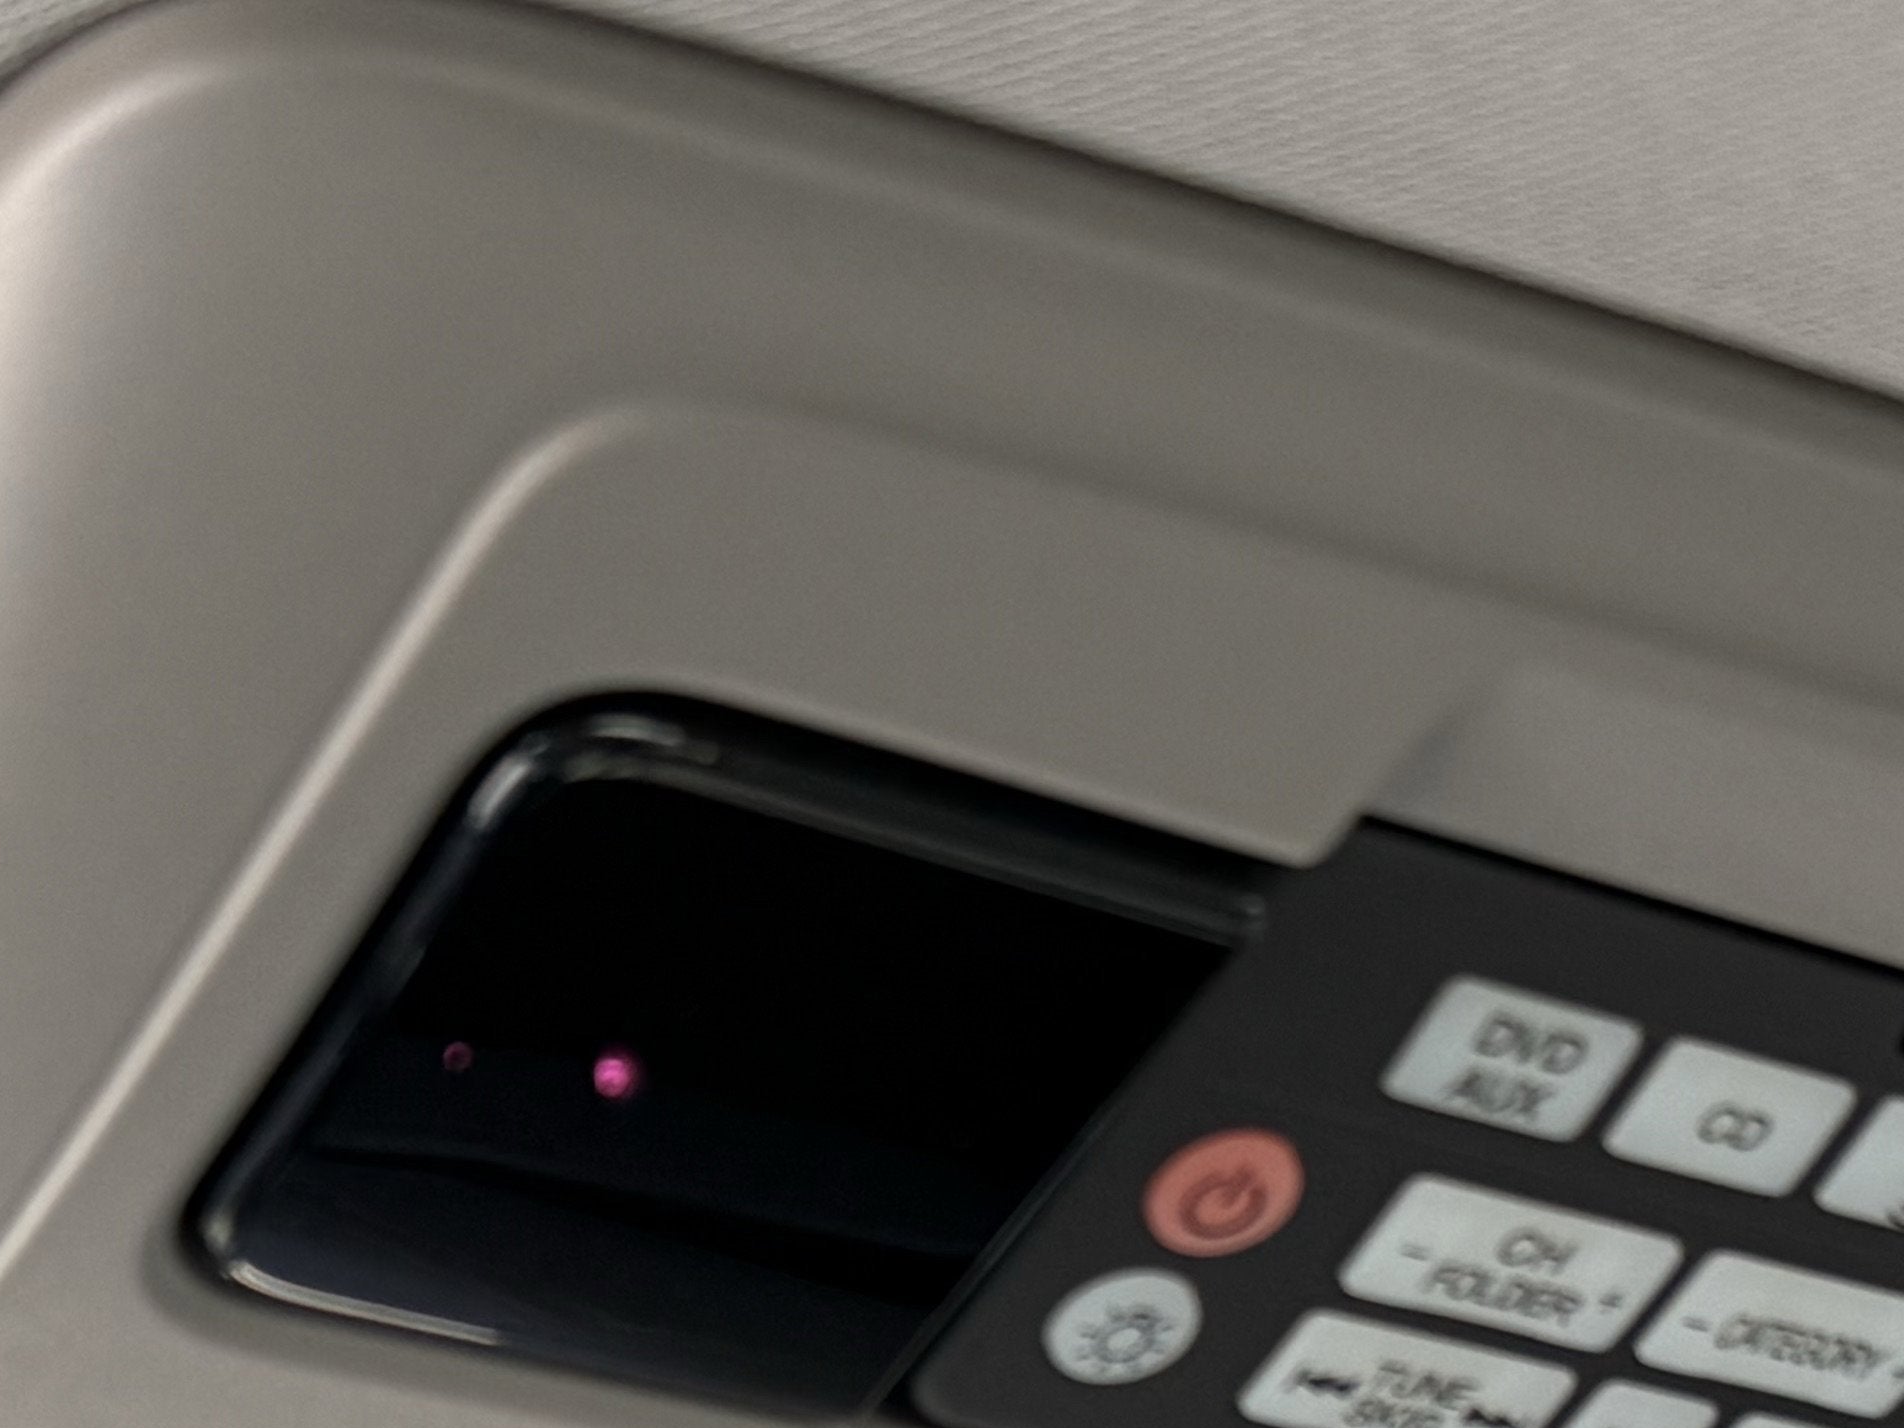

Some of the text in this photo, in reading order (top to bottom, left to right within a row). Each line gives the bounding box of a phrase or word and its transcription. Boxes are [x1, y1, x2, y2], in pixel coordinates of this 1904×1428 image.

[1472, 1008, 1591, 1077] DVD
[1446, 1064, 1551, 1120] AUX
[1697, 1101, 1774, 1153] CD
[1420, 1259, 1584, 1327] FOLDER
